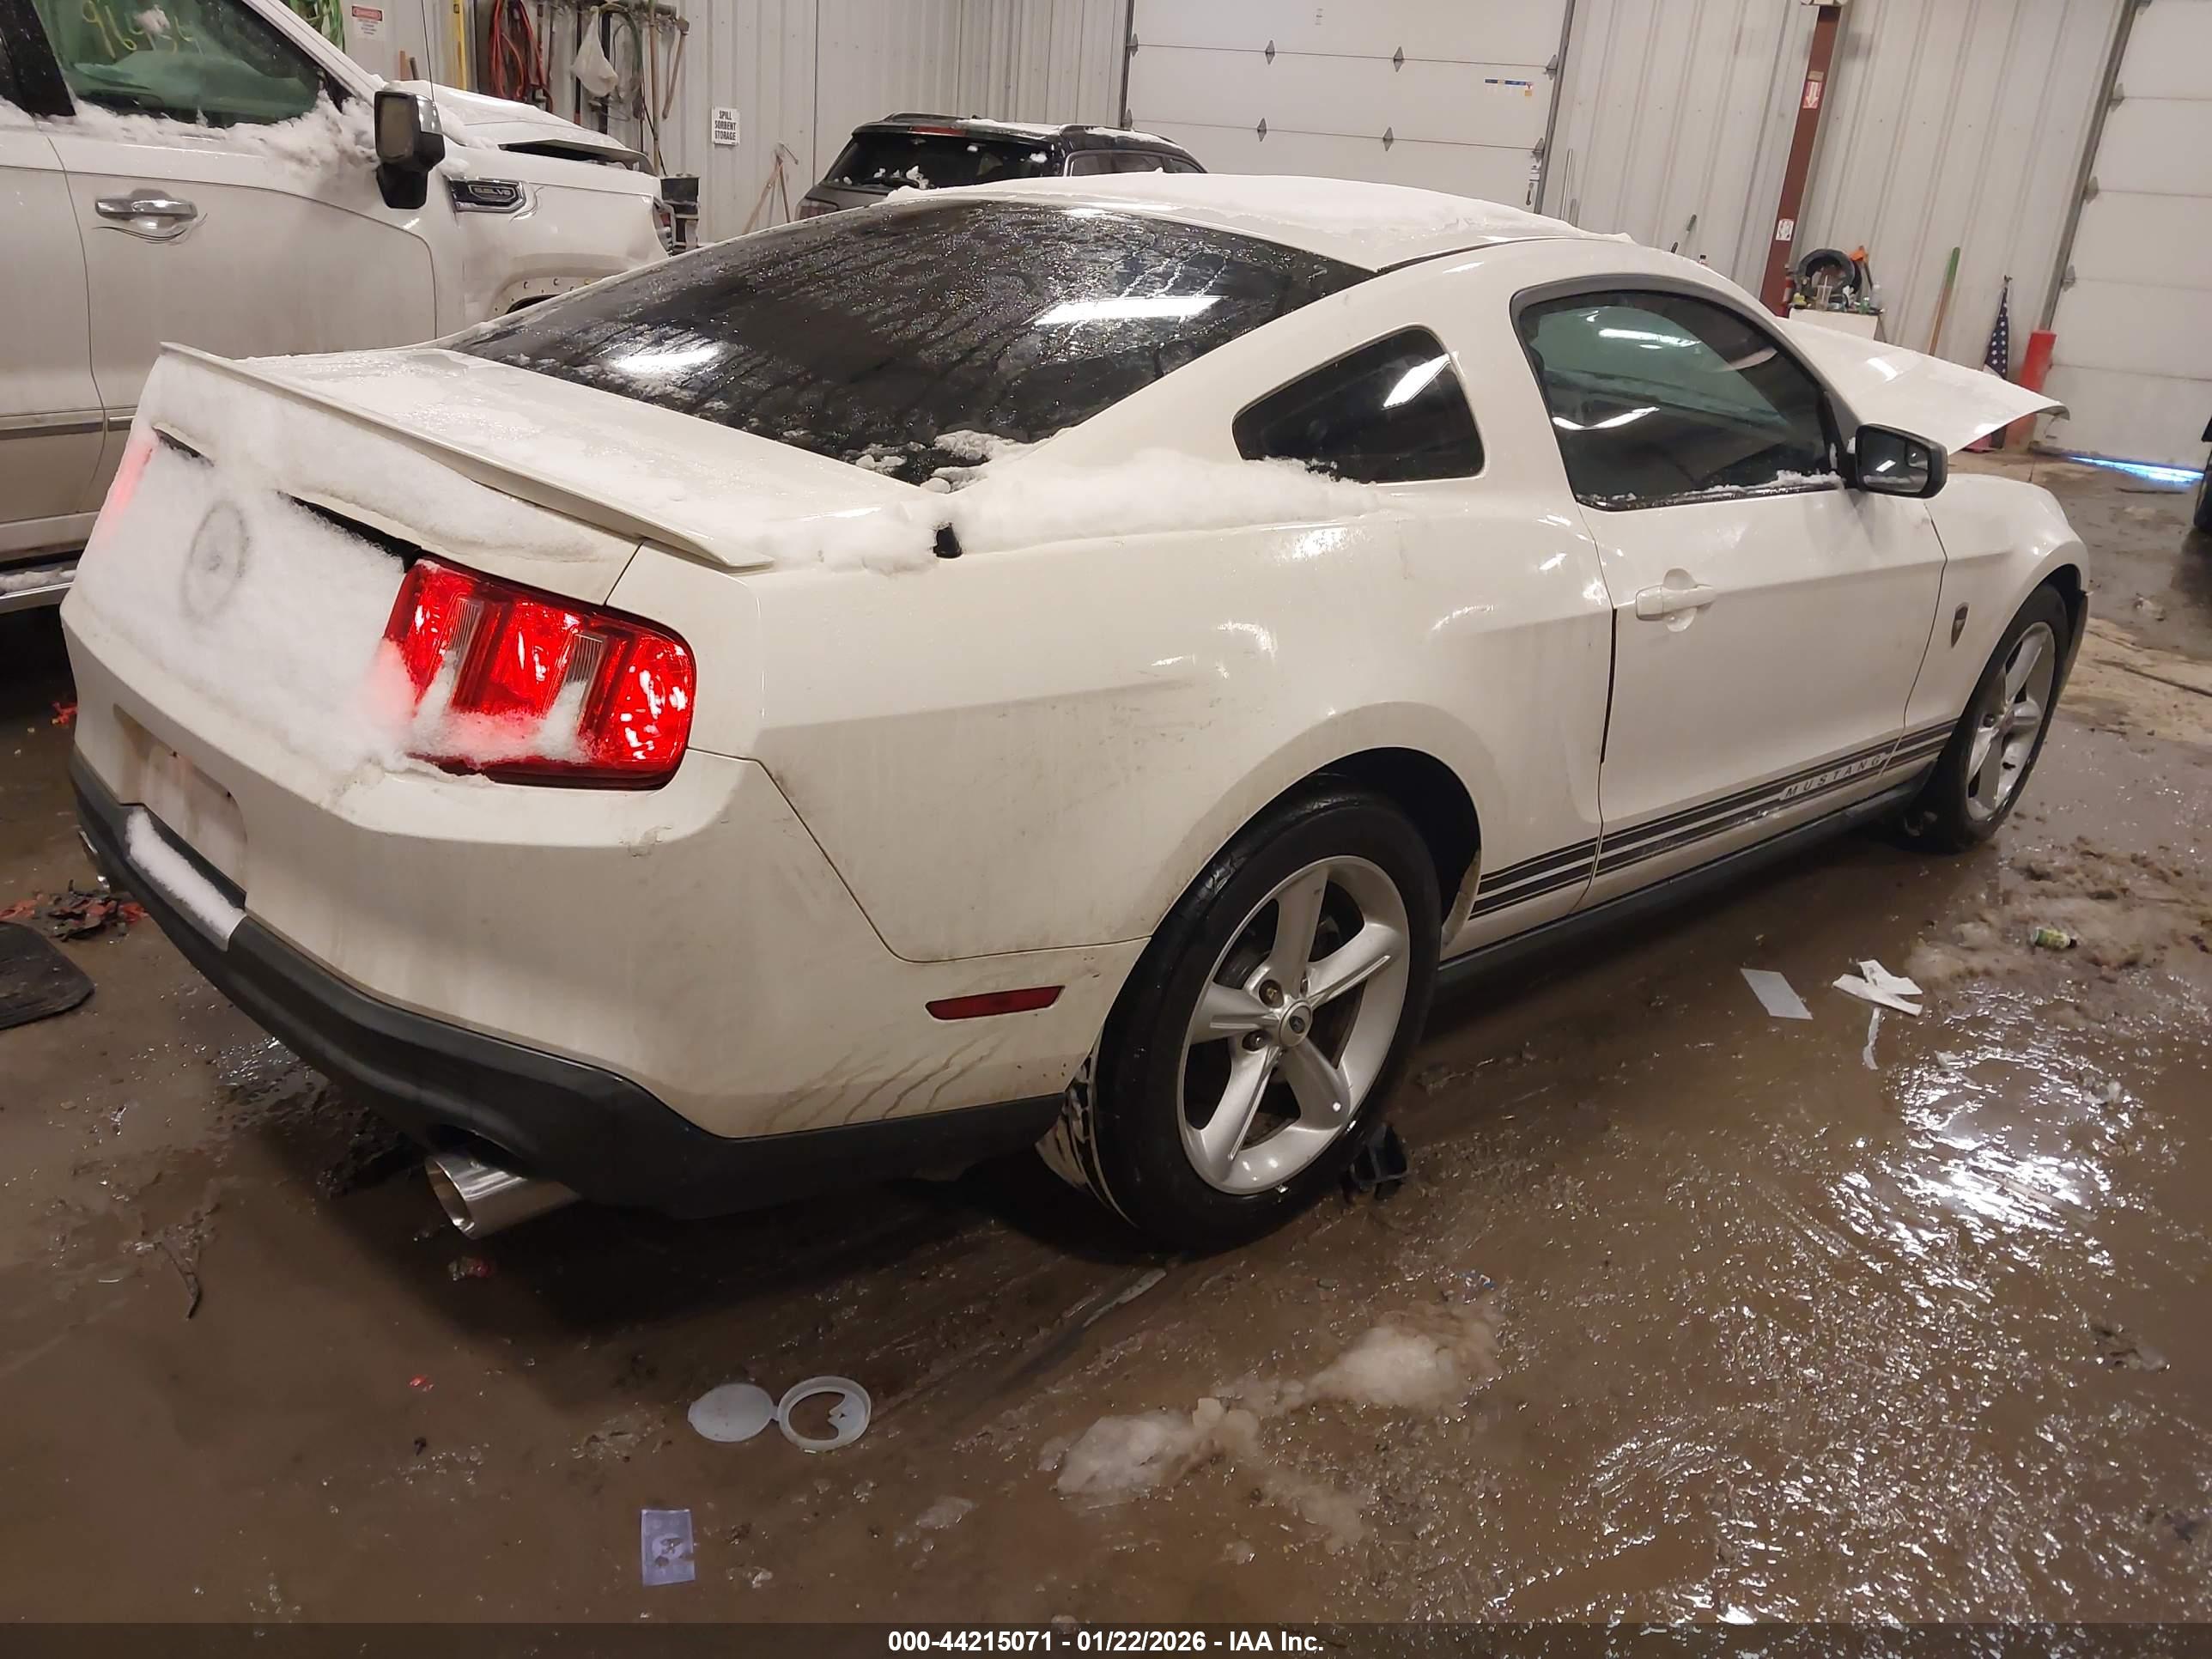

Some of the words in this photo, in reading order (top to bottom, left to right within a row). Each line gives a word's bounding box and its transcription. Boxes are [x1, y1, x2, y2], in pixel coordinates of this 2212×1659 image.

[719, 110, 732, 120] SPILL
[714, 130, 736, 140] STORAGE
[1785, 755, 1881, 798] MUSTANG
